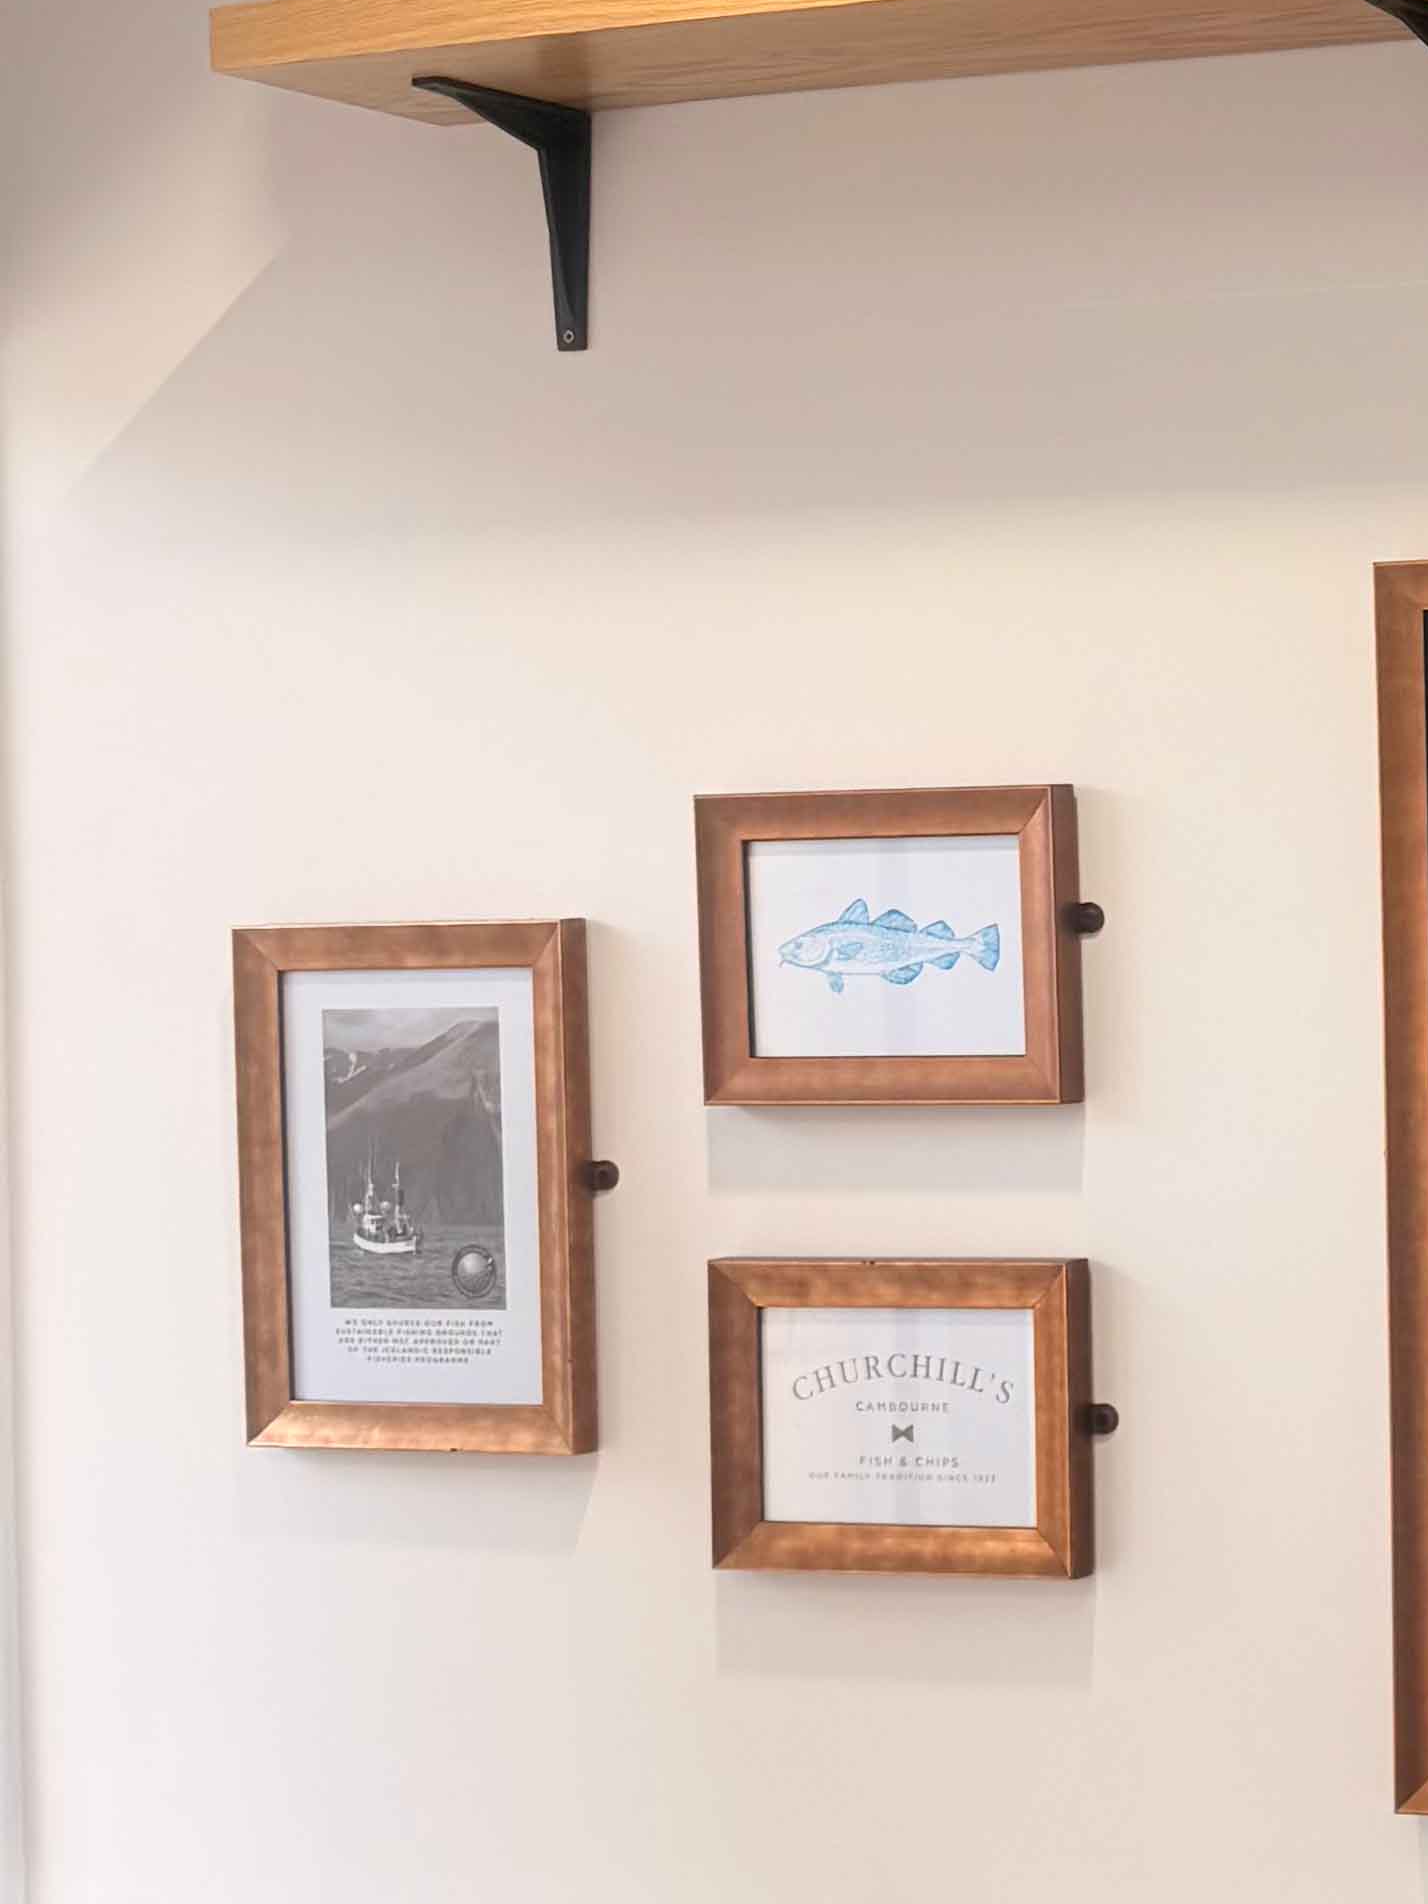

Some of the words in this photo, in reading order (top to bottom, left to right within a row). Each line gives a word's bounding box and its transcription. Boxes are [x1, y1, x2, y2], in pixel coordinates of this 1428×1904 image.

[792, 1353, 1014, 1404] CHURCHILL'S
[856, 1401, 950, 1413] CAMBOURNE
[859, 1456, 893, 1466] FISH
[899, 1456, 908, 1467] &
[915, 1456, 959, 1467] CHIPS
